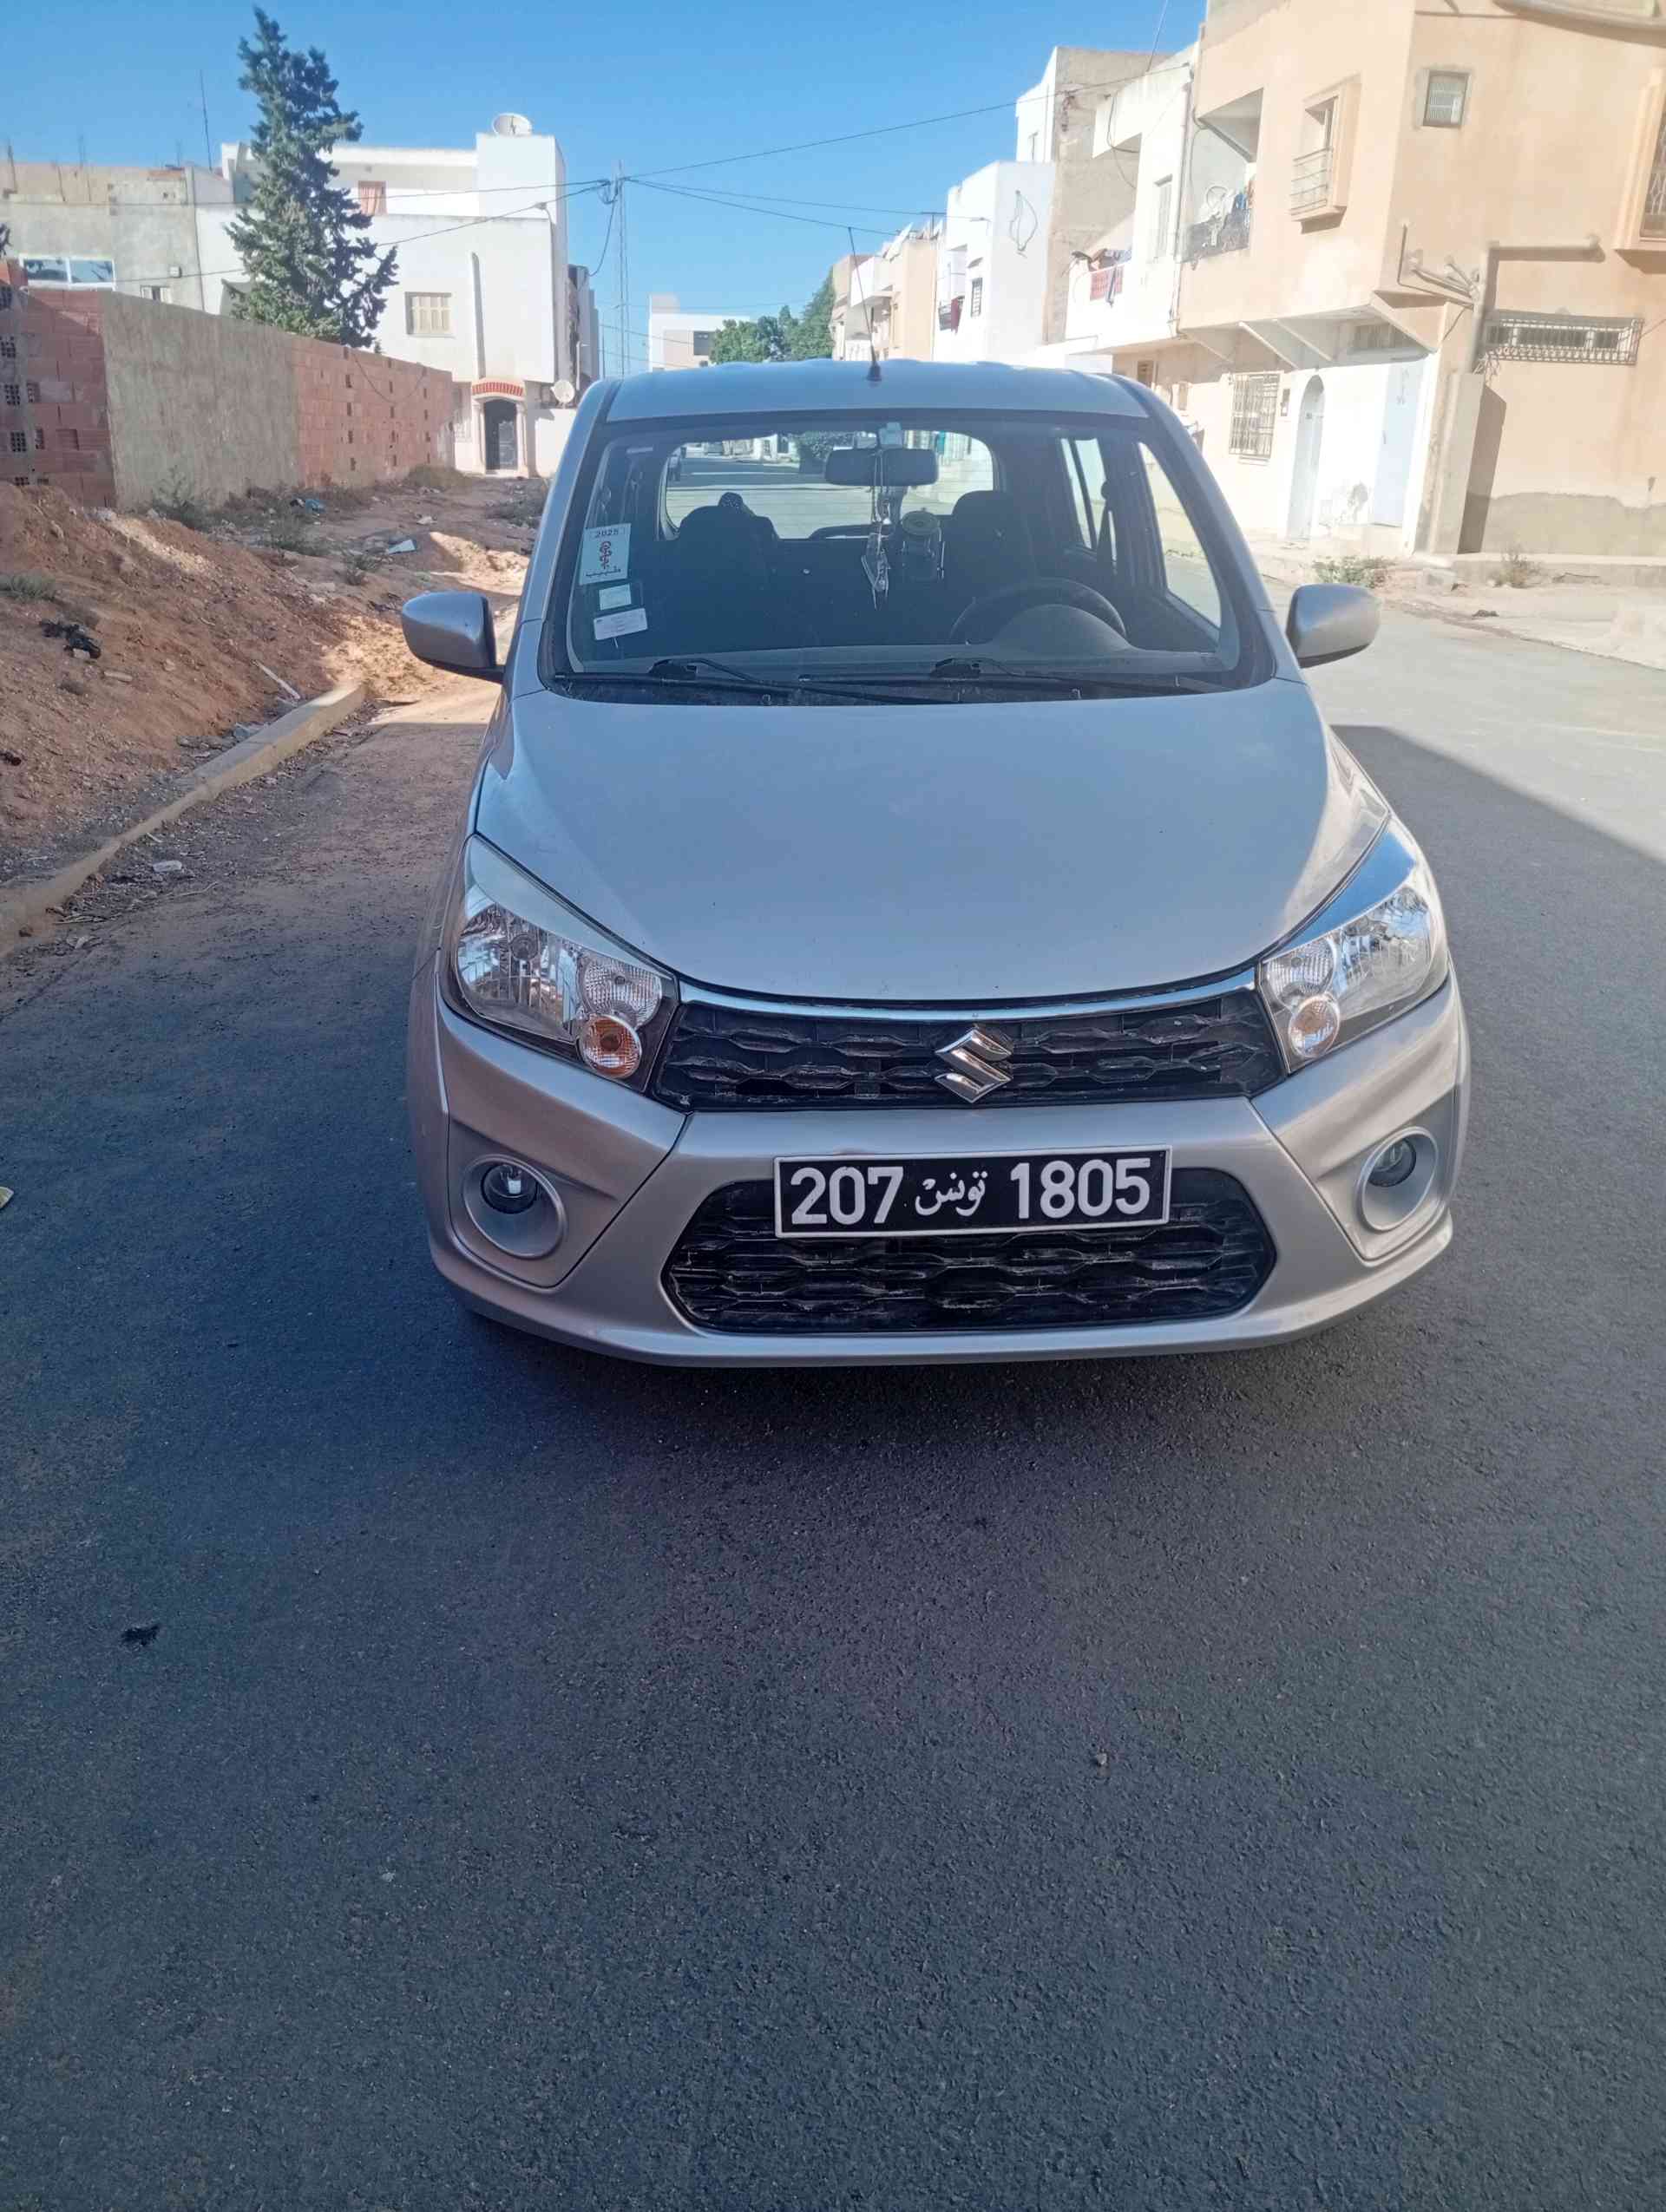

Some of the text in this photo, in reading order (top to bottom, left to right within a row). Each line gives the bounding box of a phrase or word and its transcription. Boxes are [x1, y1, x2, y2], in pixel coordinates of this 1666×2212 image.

[790, 1157, 1151, 1225] 207 تونس 1805
